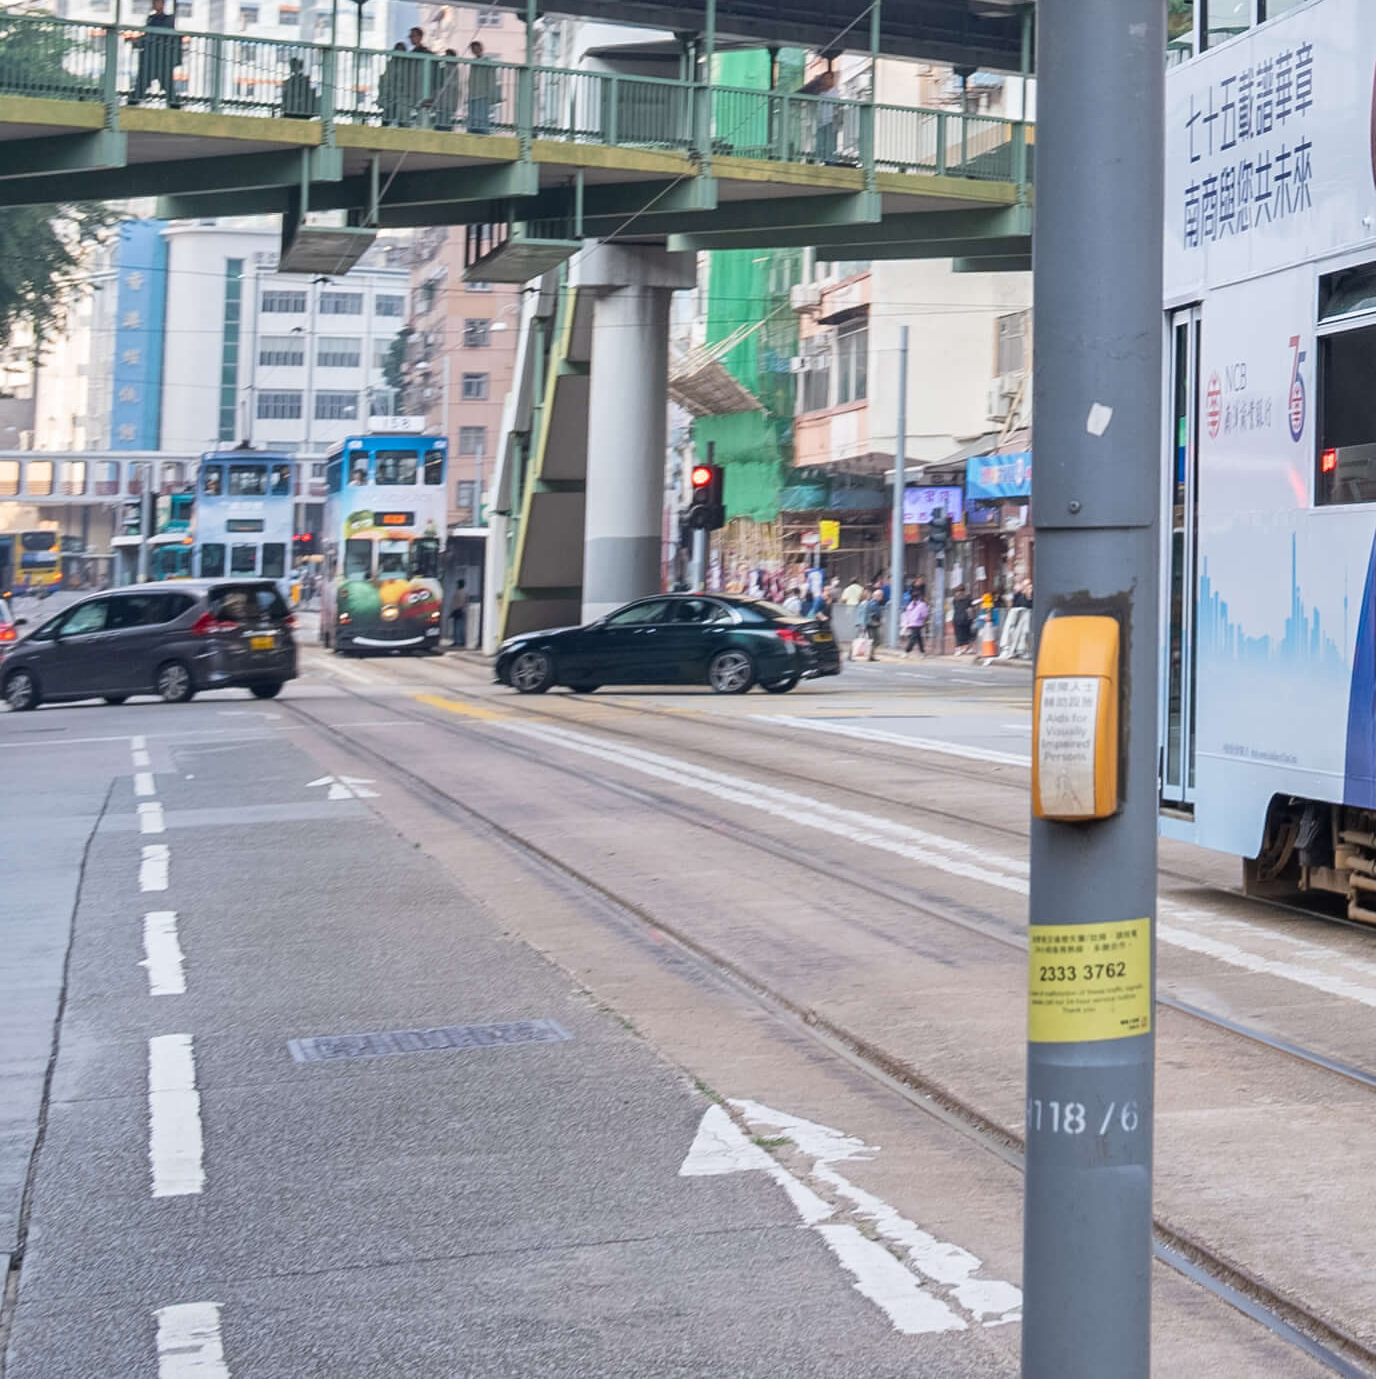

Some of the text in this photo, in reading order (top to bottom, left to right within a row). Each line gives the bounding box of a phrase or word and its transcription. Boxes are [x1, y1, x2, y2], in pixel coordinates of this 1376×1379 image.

[1185, 41, 1313, 163] 七十五載譜華章
[1183, 135, 1313, 251] 南商與您共未來
[1224, 362, 1248, 393] NCB
[1040, 961, 1126, 982] 2333 3762
